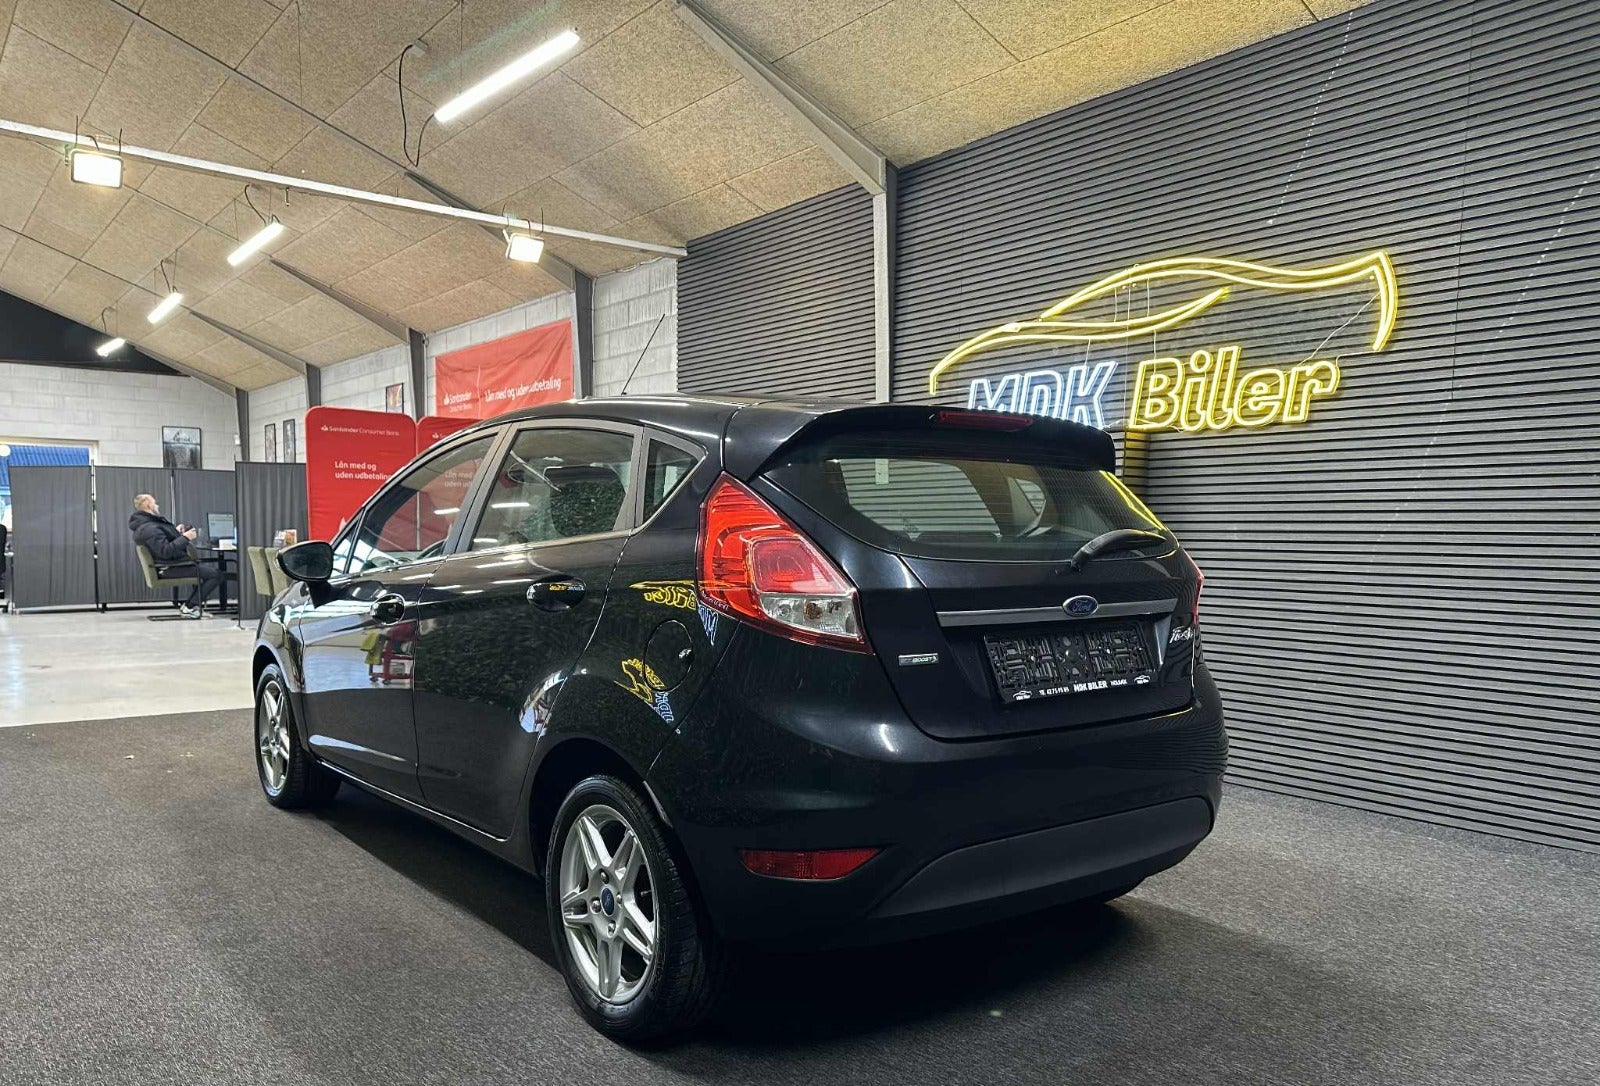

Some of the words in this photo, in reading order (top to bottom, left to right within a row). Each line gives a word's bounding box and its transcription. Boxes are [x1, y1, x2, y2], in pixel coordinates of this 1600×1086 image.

[968, 360, 1119, 431] MDK
[1127, 345, 1341, 431] Biler
[329, 425, 358, 433] Santander
[334, 460, 348, 469] Lån
[349, 461, 366, 470] med
[367, 463, 377, 472] og
[335, 471, 354, 479] uden
